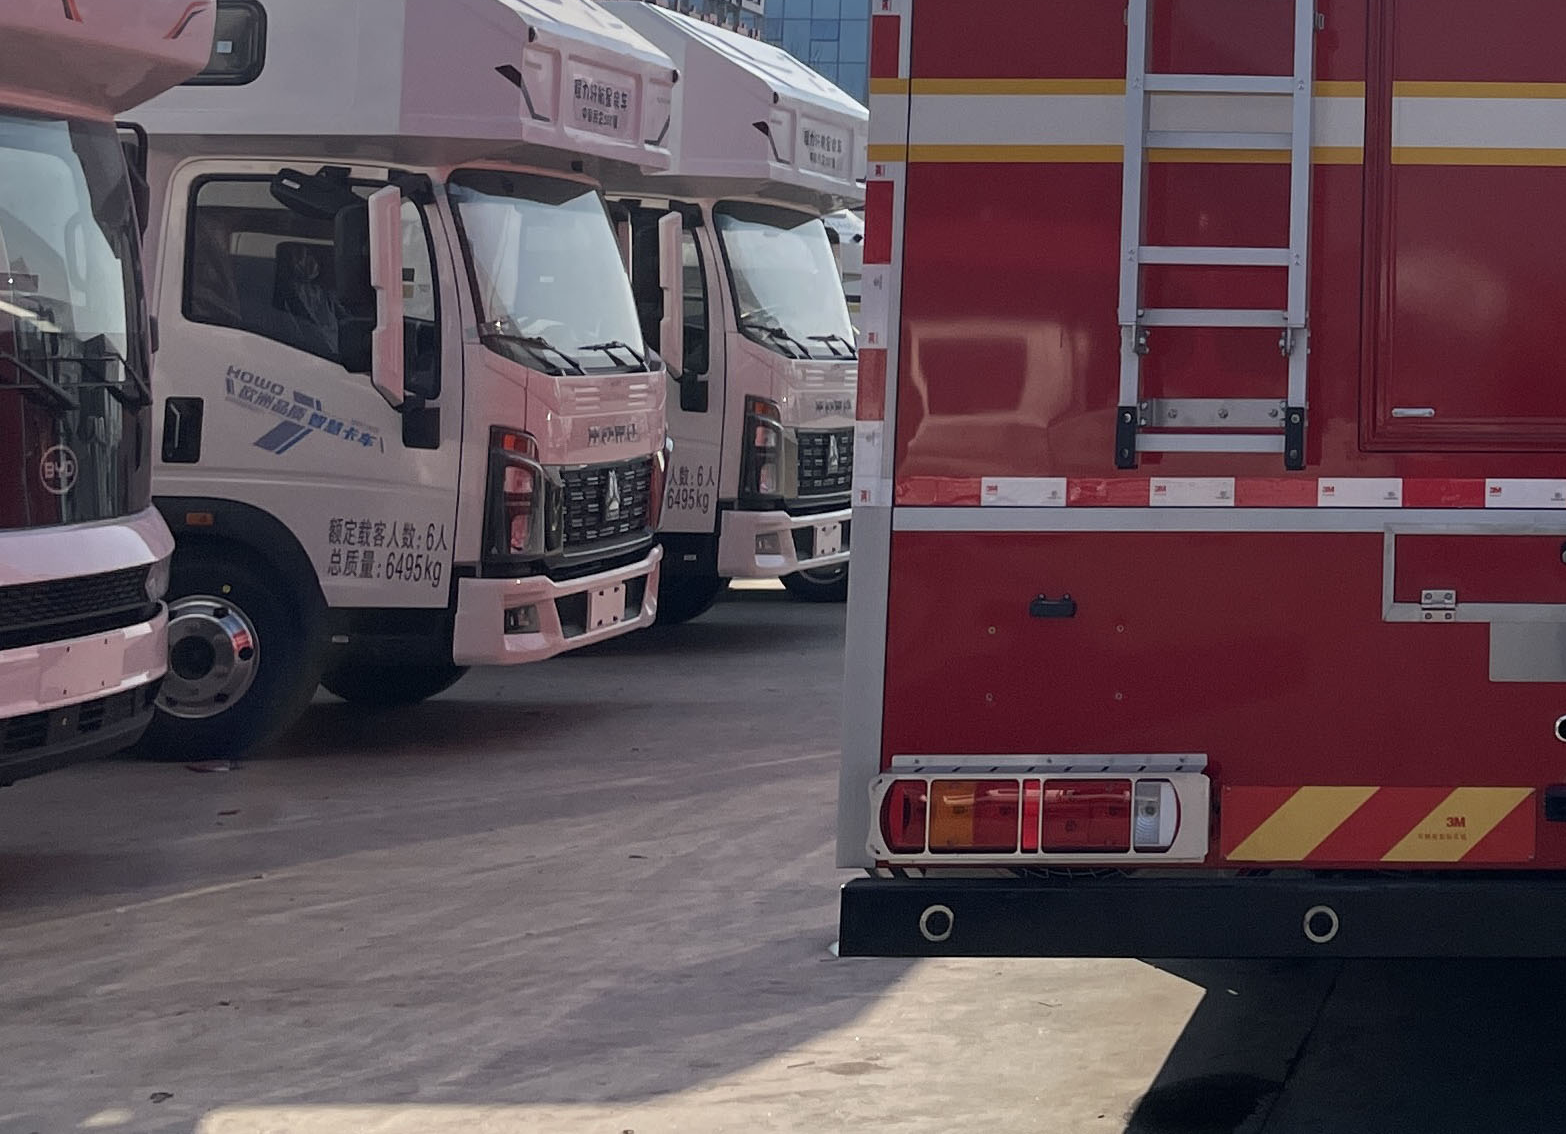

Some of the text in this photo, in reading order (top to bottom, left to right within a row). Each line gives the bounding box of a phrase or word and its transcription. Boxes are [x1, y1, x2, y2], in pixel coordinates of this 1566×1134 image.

[226, 366, 284, 396] HOWO
[44, 459, 75, 479] BYD
[667, 489, 710, 515] 6495kg
[1446, 816, 1466, 827] 3M
